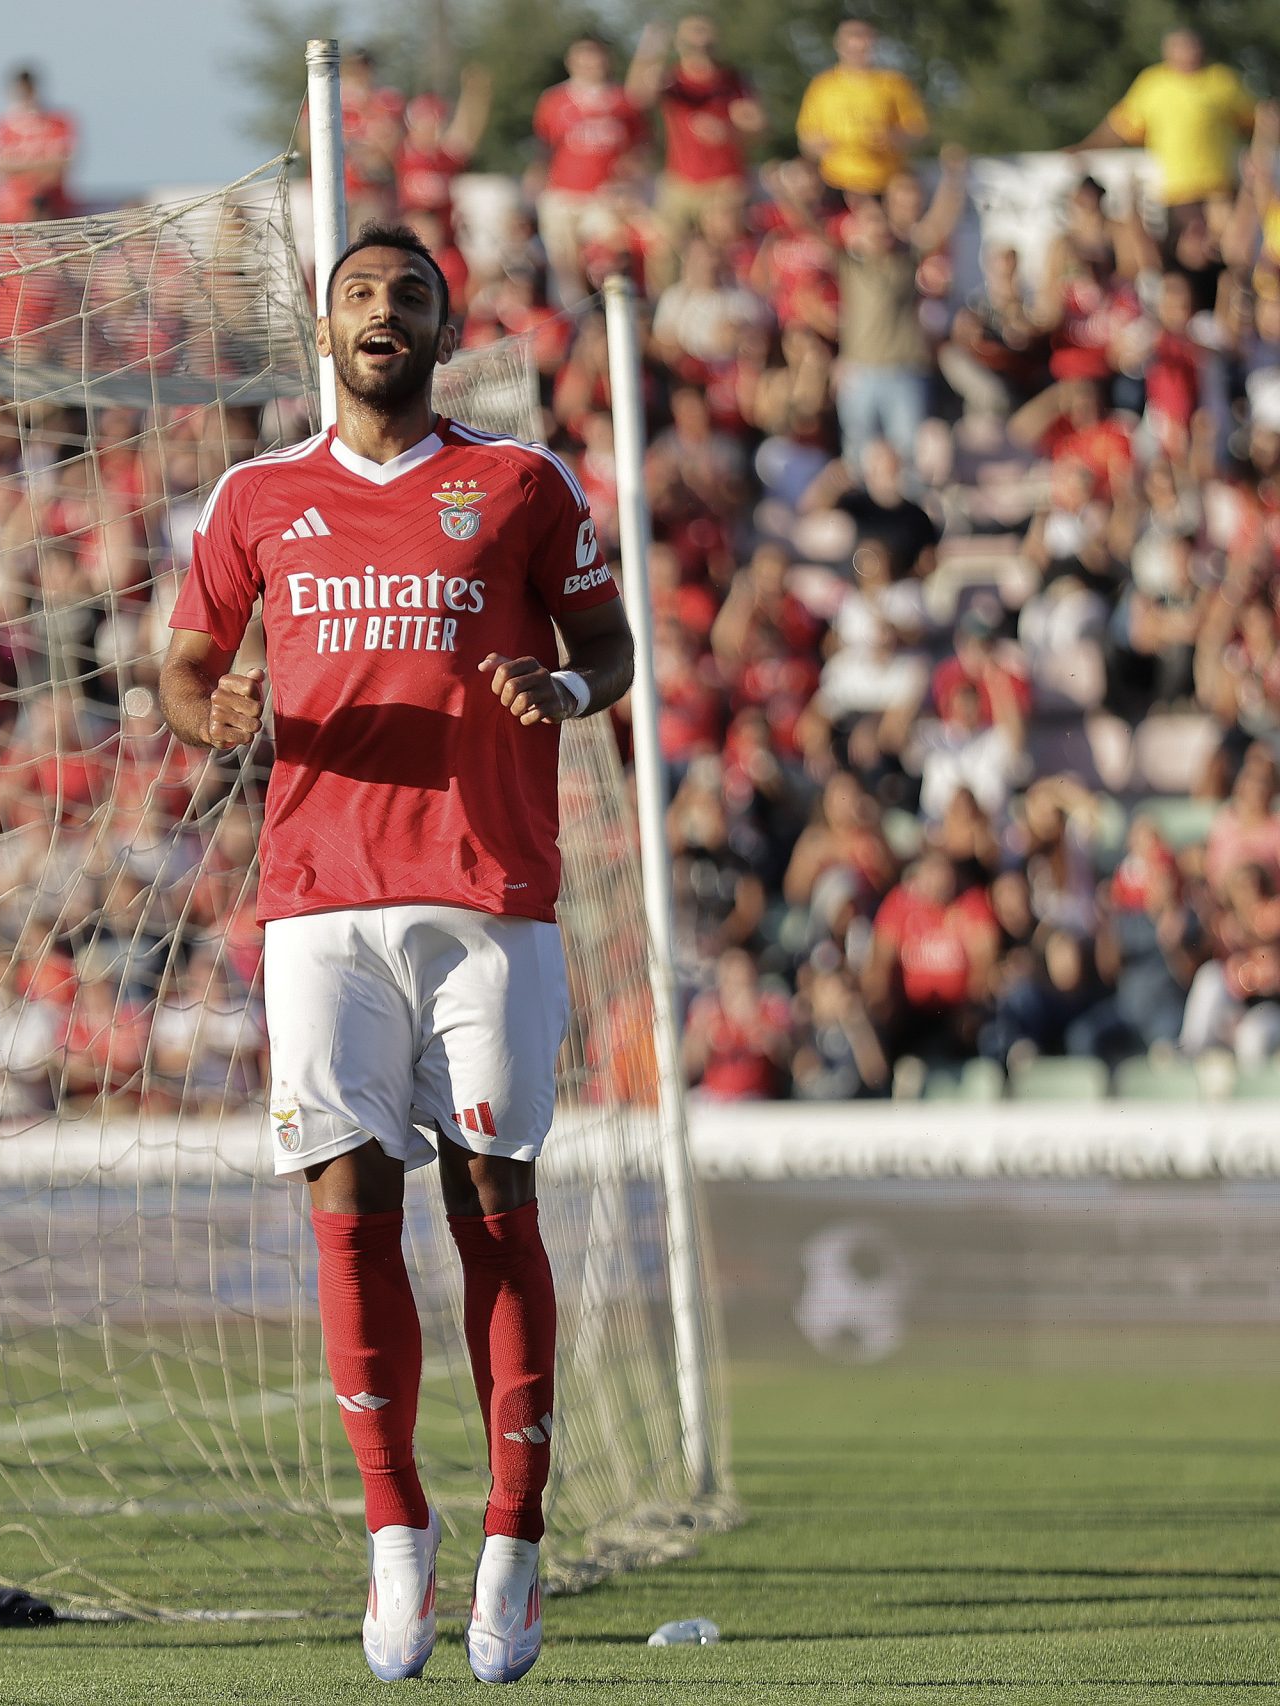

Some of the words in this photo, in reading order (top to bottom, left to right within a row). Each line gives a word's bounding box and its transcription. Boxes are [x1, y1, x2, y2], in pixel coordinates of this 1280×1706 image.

[287, 565, 486, 617] Emirates
[563, 563, 613, 595] Betan
[317, 617, 358, 654] FLY
[364, 615, 458, 652] BETTER
